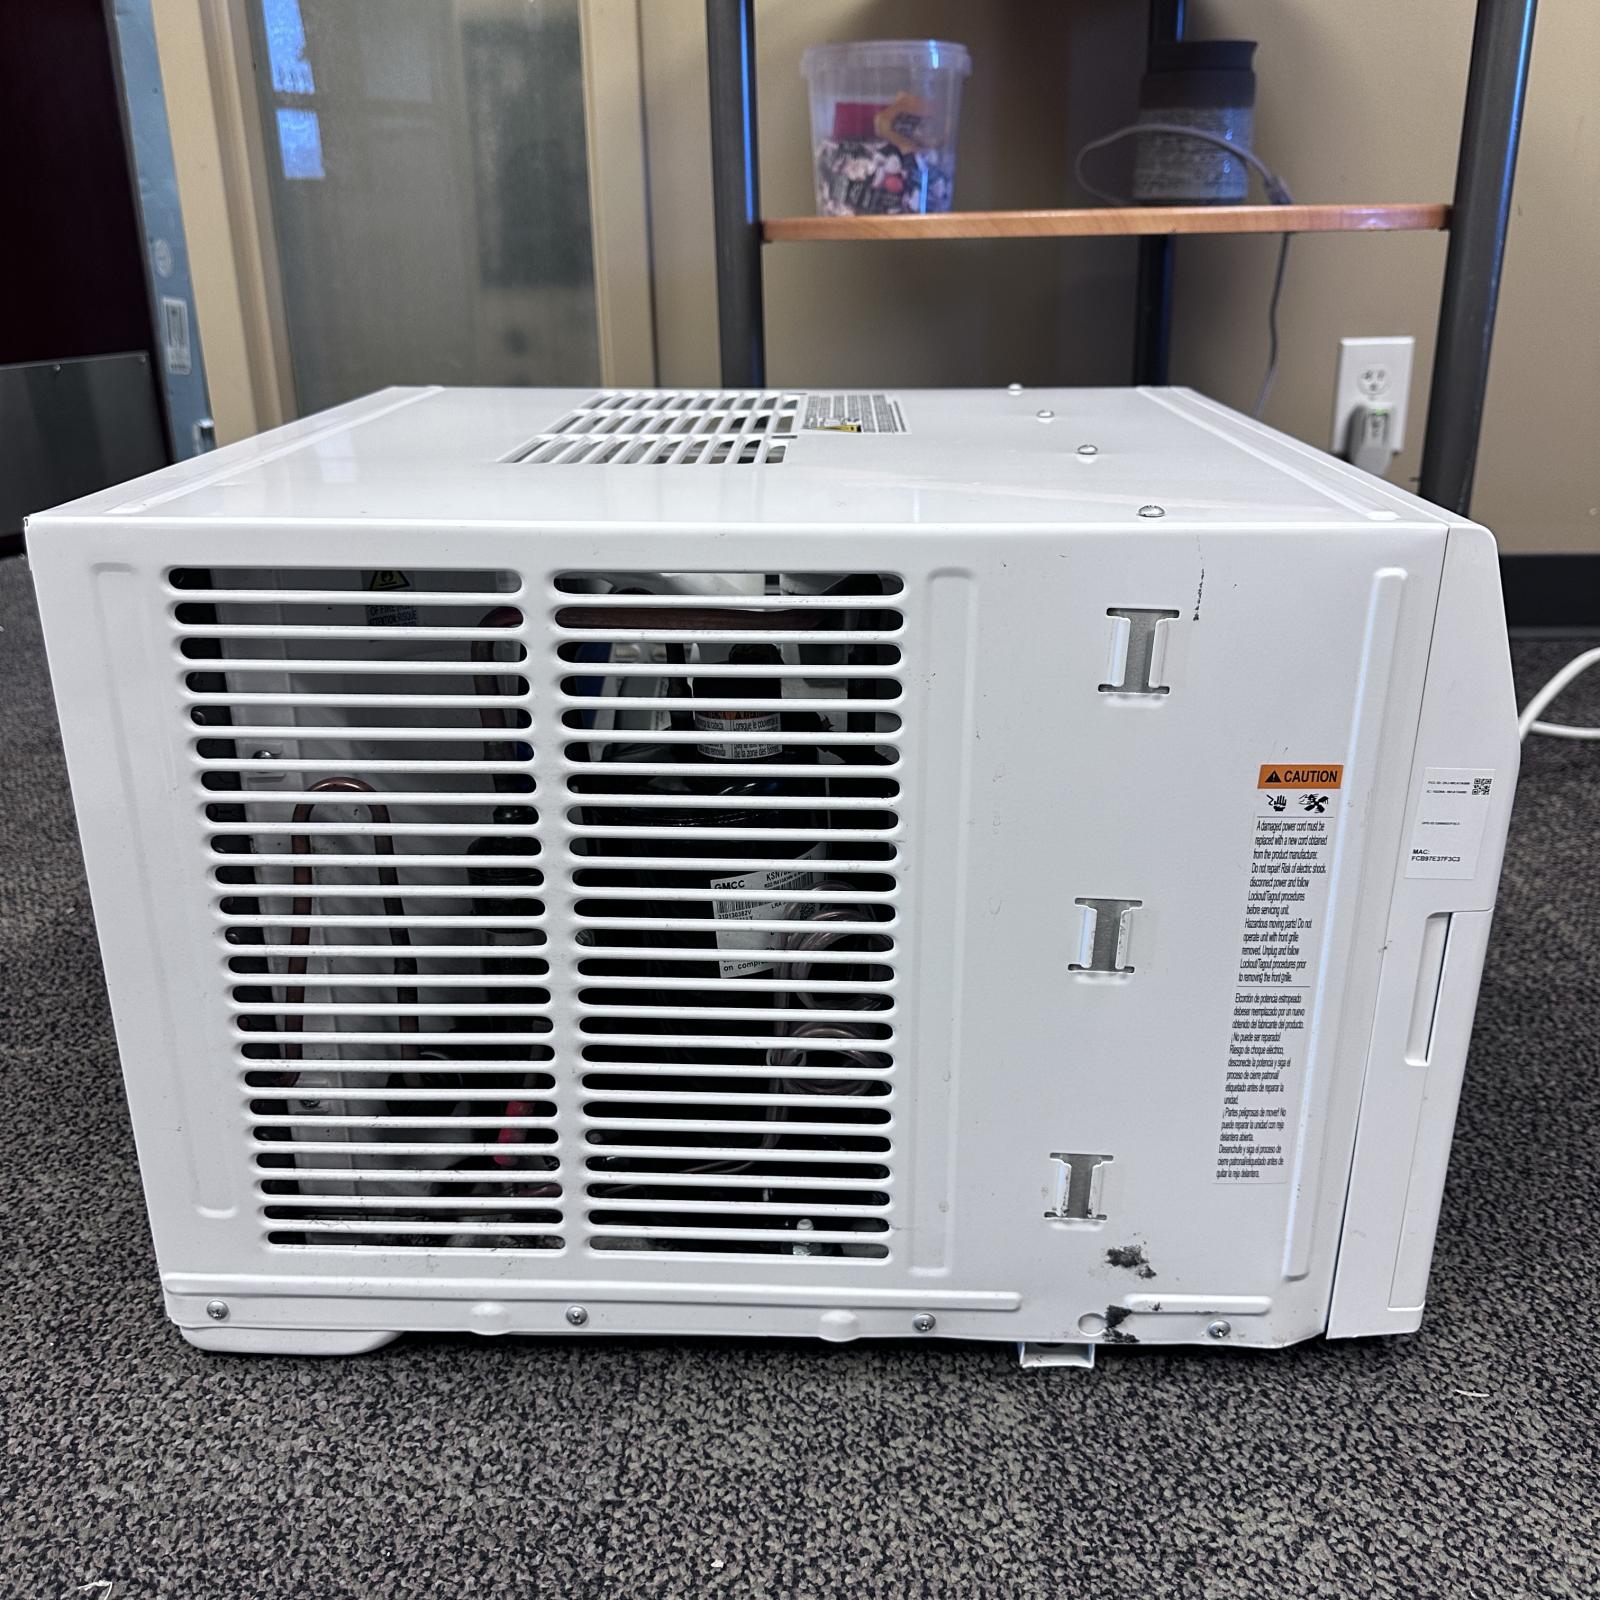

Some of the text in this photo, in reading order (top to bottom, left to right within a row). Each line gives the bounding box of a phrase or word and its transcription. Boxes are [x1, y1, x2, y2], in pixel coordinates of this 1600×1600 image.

[1284, 770, 1337, 782] CAUTION
[1256, 820, 1325, 834] A damaged power cord must be
[1255, 835, 1328, 847] replaced with a new cord obtained
[1253, 848, 1263, 859] from
[1272, 848, 1288, 861] product
[1252, 863, 1258, 873] Do
[1281, 863, 1291, 873] Risk
[1292, 863, 1297, 873] of
[1297, 863, 1312, 873] electric
[715, 880, 744, 889] GMCC
[1250, 877, 1310, 889] disconnect power and follow
